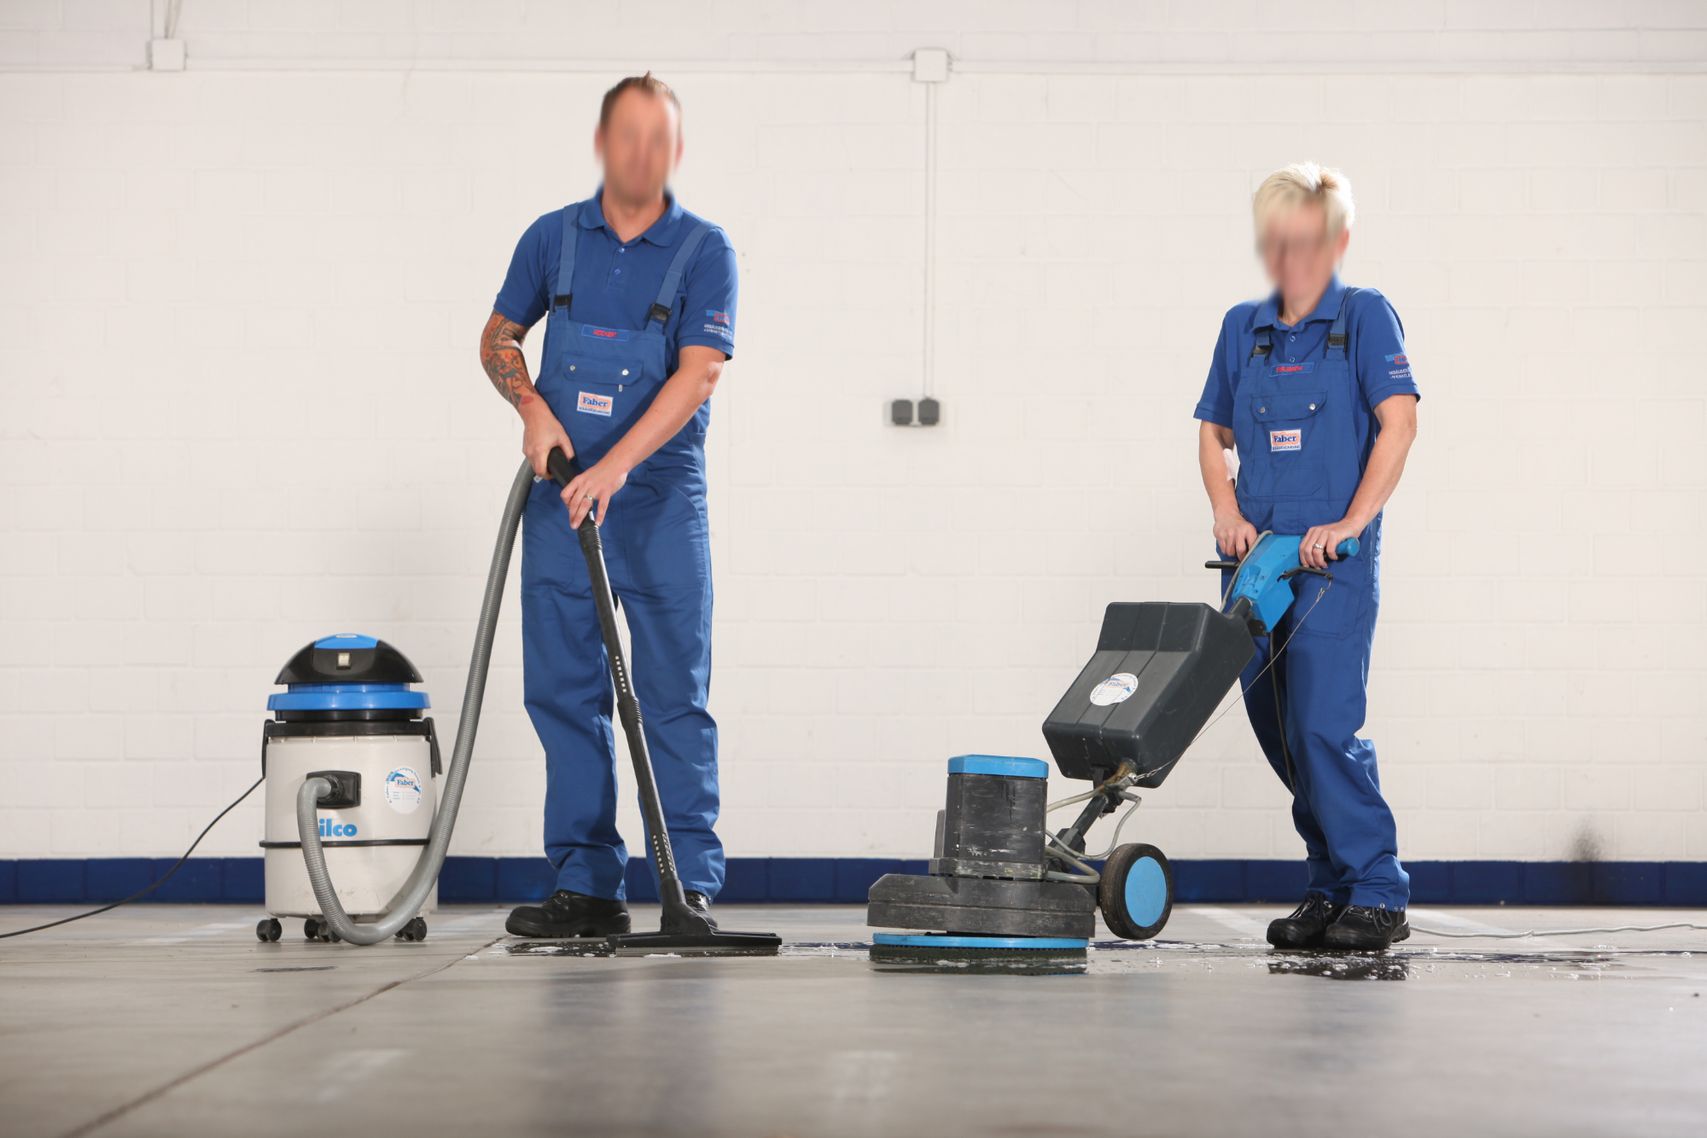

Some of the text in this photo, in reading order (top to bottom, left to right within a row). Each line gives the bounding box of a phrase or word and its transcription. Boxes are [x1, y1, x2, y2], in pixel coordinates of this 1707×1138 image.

[583, 397, 608, 407] Faber
[1274, 435, 1297, 443] Faber
[319, 818, 357, 837] ilco
